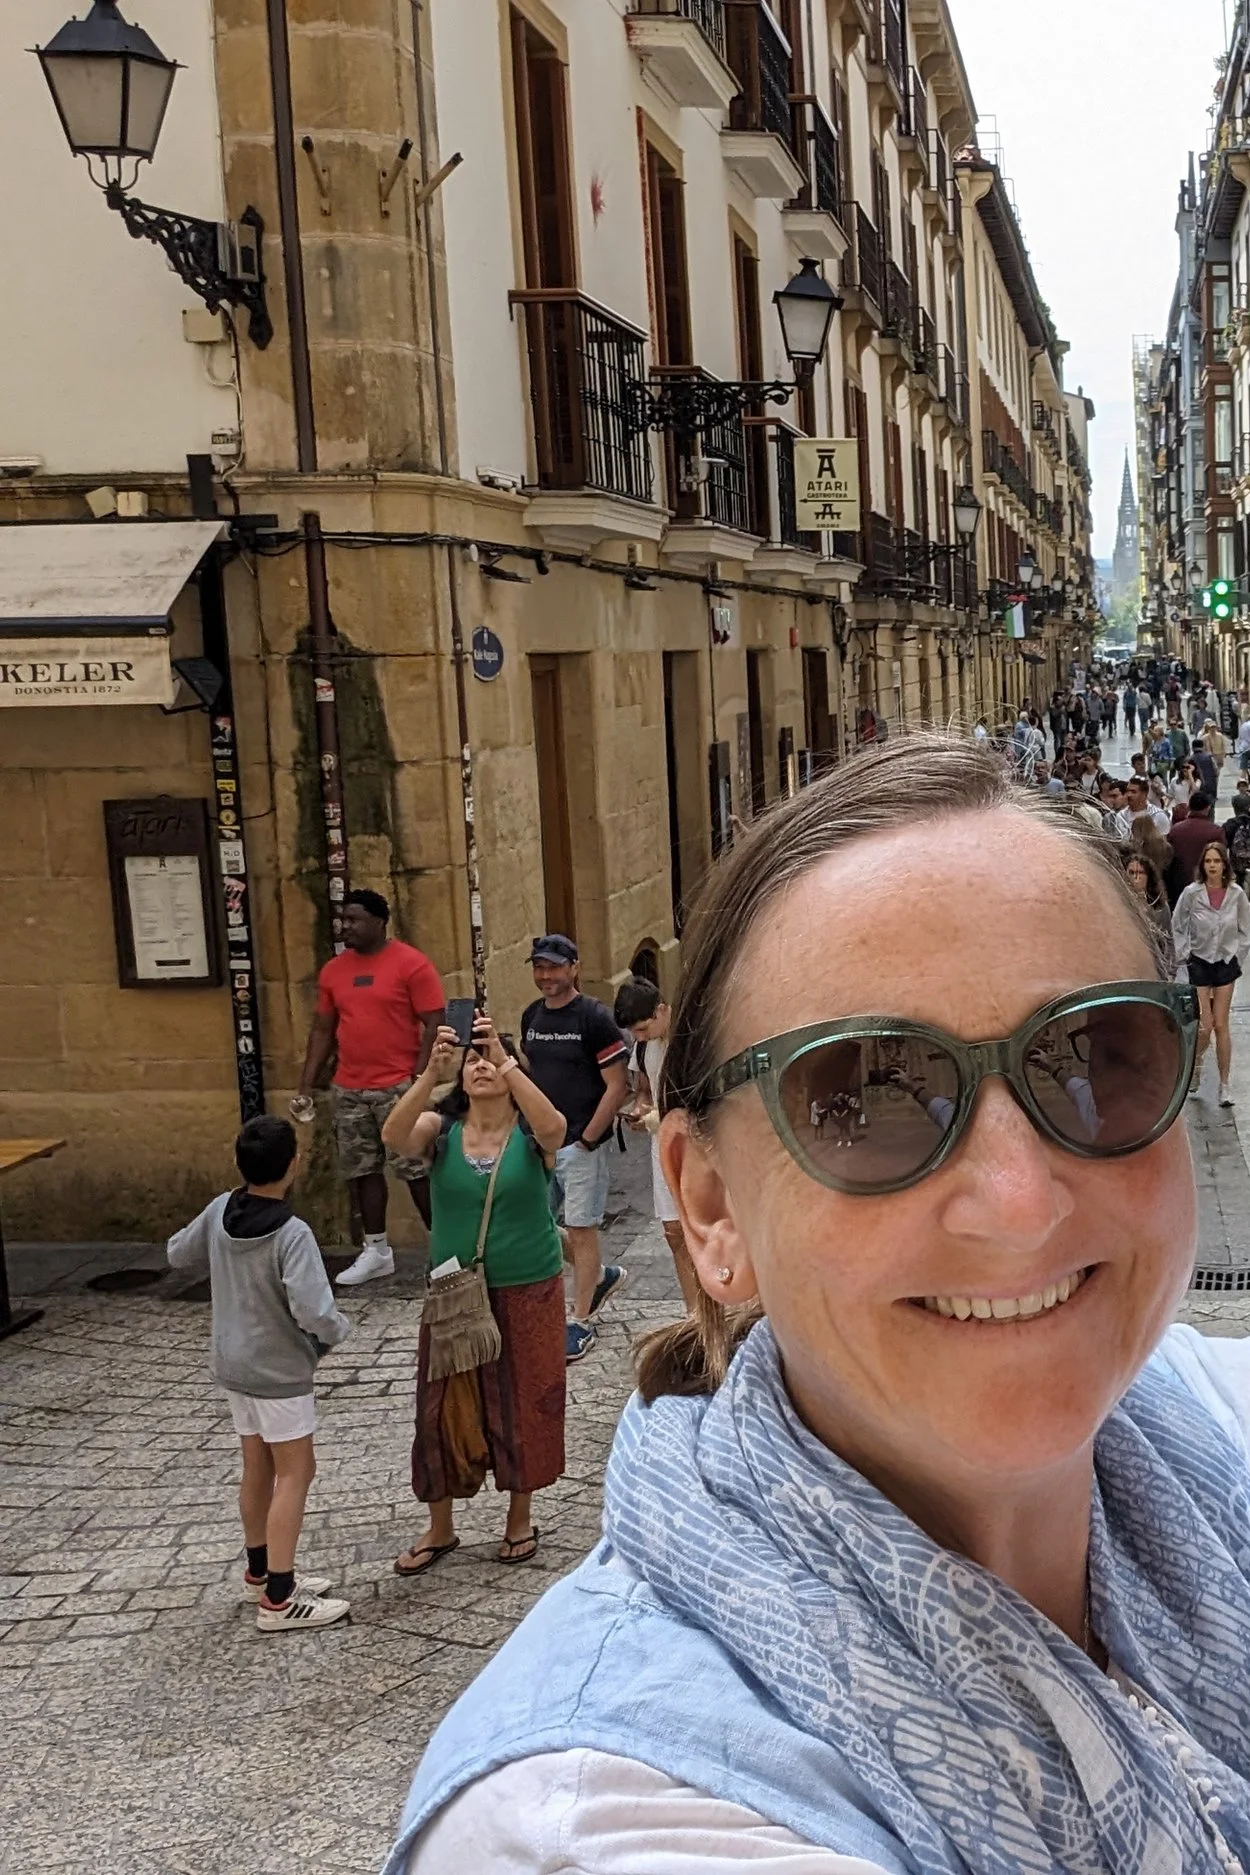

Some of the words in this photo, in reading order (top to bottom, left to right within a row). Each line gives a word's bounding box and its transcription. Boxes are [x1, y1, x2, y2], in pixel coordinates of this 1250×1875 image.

[807, 481, 848, 491] ATARI
[0, 661, 135, 684] KELER
[14, 685, 89, 695] DONOSTIA
[93, 685, 121, 693] 1872
